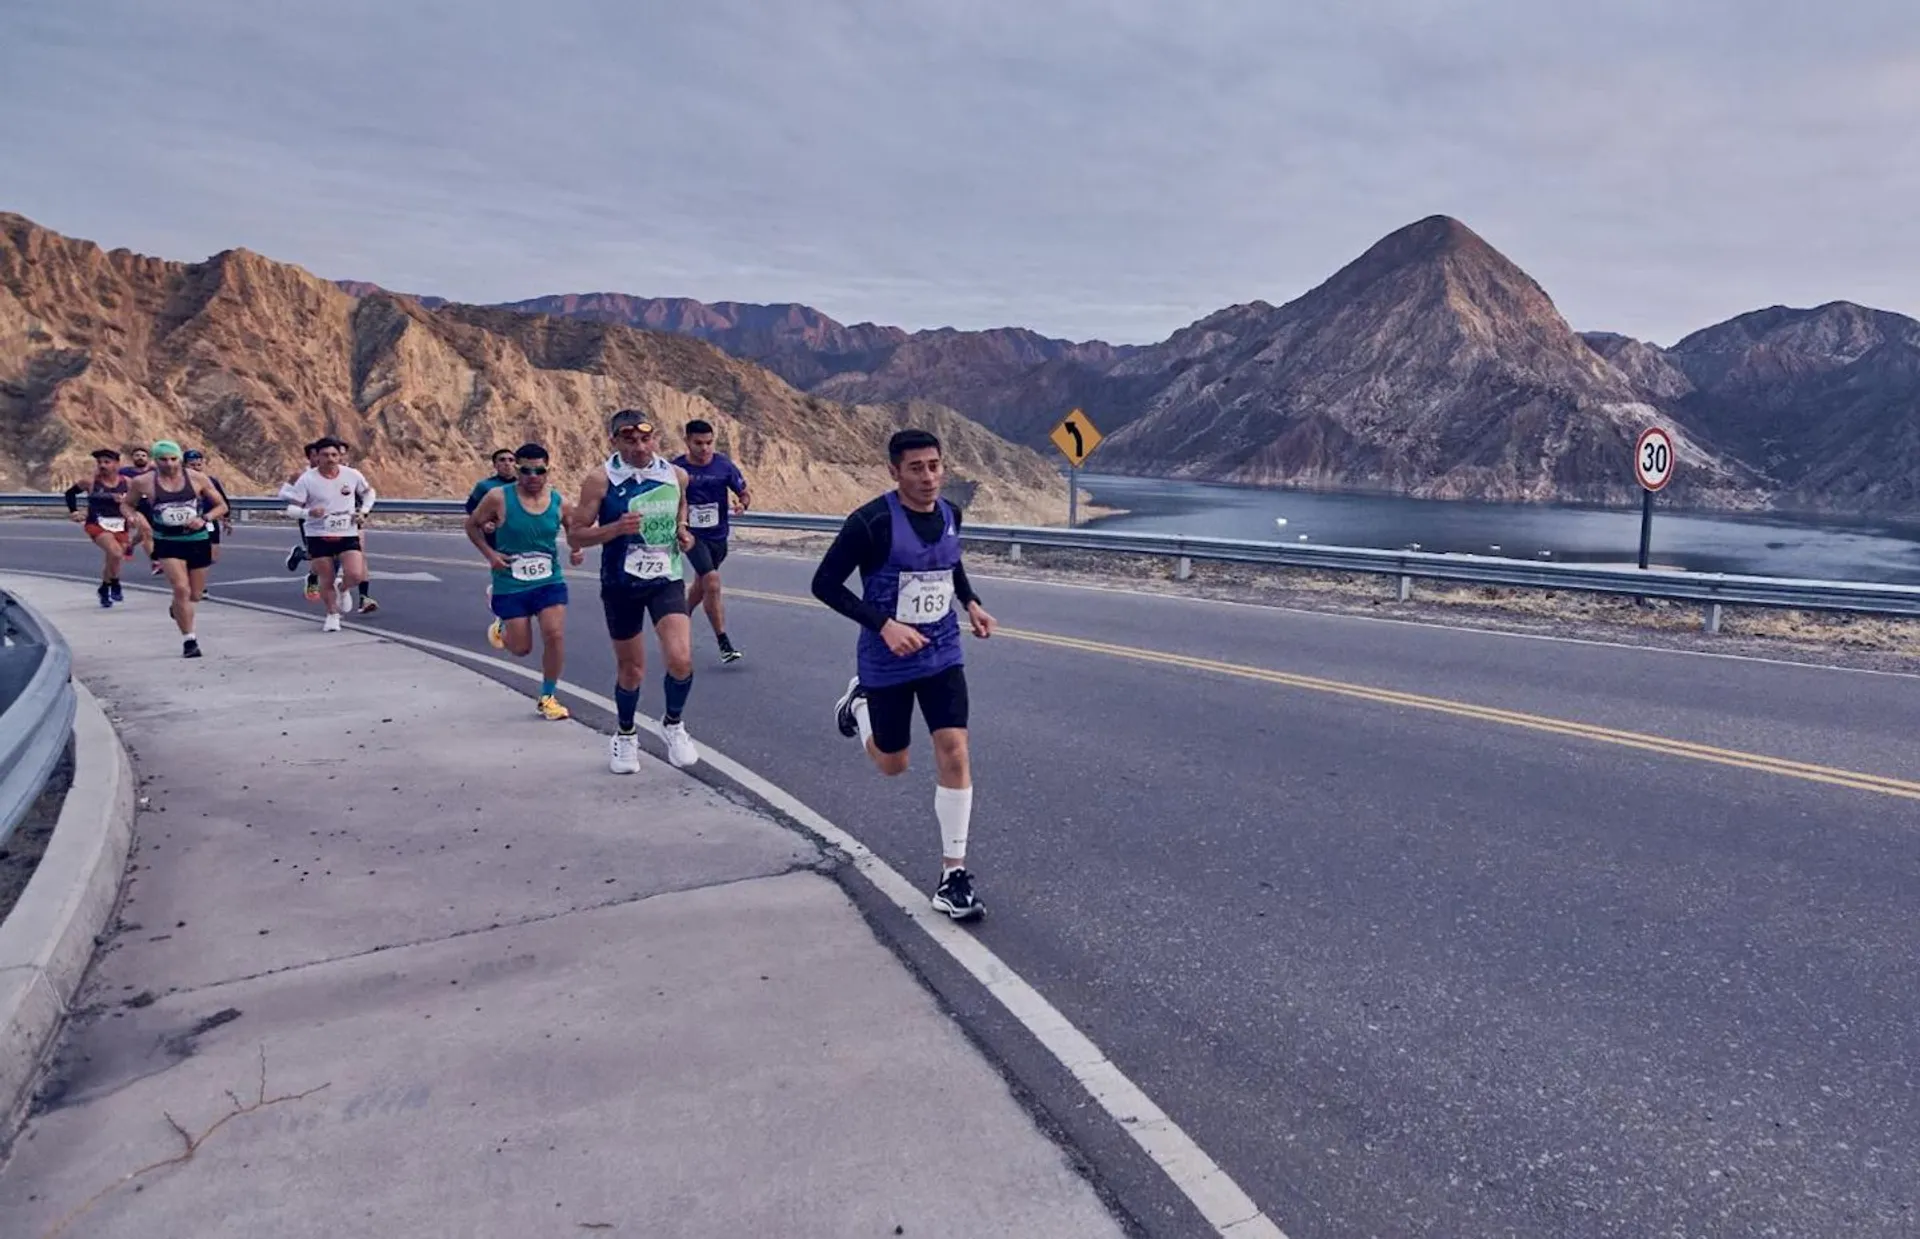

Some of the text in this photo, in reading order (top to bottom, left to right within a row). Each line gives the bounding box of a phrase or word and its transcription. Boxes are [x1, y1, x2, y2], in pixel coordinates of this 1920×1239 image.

[1643, 443, 1667, 473] 30
[521, 562, 546, 576] 165
[635, 560, 664, 574] 173
[912, 594, 945, 614] 163
